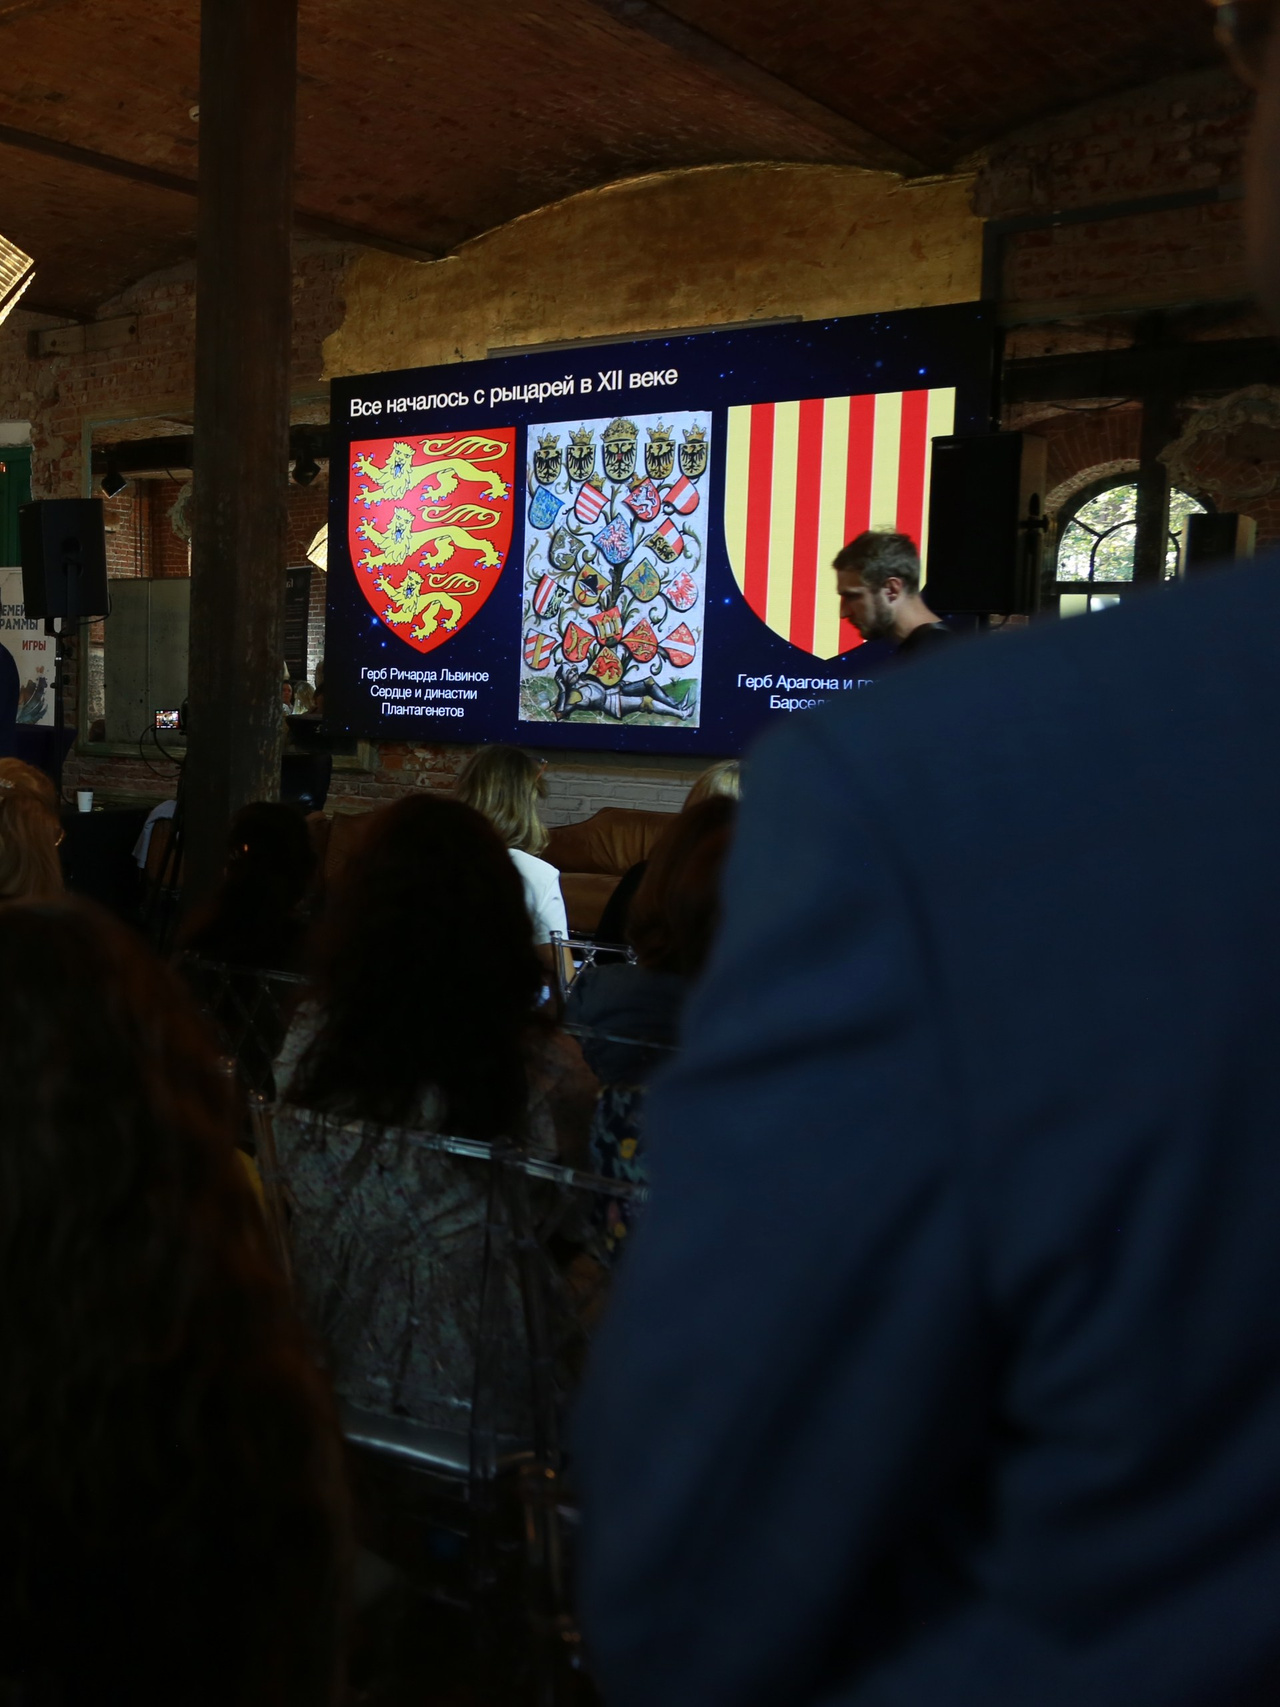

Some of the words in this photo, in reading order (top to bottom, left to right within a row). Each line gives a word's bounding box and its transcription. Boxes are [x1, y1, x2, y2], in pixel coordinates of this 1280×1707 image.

[350, 398, 382, 417] Все
[386, 391, 469, 413] началось
[473, 388, 485, 404] с
[490, 375, 574, 408] рыцарей
[580, 377, 593, 394] в
[597, 369, 623, 393] XII
[629, 368, 679, 389] веке
[0, 618, 39, 630] РАММЫ
[22, 640, 46, 651] ИГРЫ
[360, 667, 387, 682] Герб
[390, 667, 437, 683] Ричарда
[439, 668, 490, 682] Львиное
[737, 674, 773, 691] Герб
[776, 674, 839, 692] Арагона
[843, 679, 853, 690] и
[370, 685, 412, 700] Сердце
[414, 689, 422, 698] и
[424, 689, 478, 701] династии
[381, 702, 465, 717] Плантагенетов
